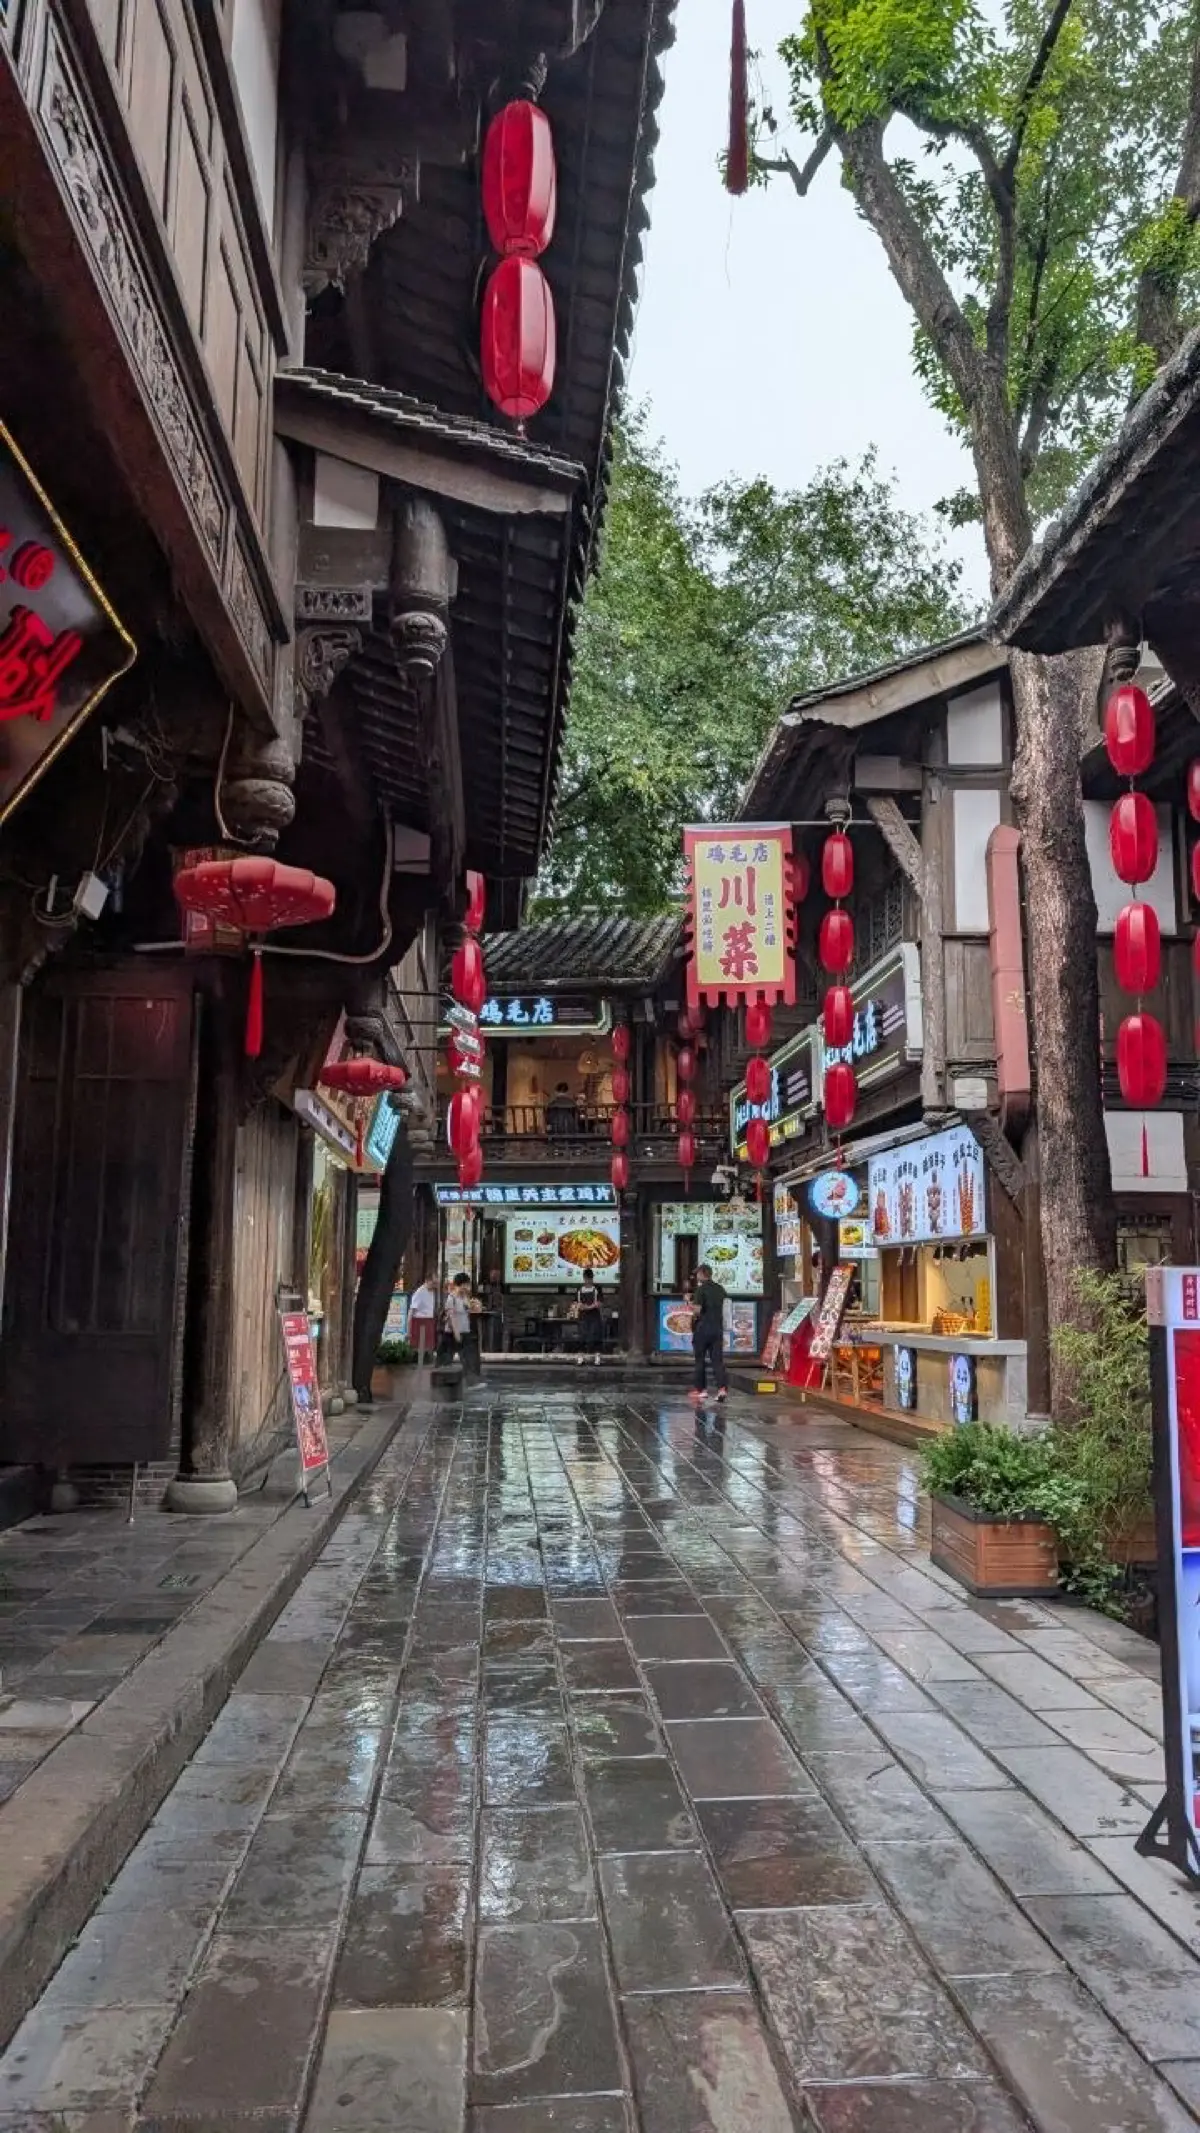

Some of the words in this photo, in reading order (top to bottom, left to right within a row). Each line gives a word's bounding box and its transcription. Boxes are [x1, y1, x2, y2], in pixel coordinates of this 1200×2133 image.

[706, 843, 770, 864] 鸡毛店
[717, 866, 759, 981] 川菜
[479, 998, 553, 1024] 鸡毛店
